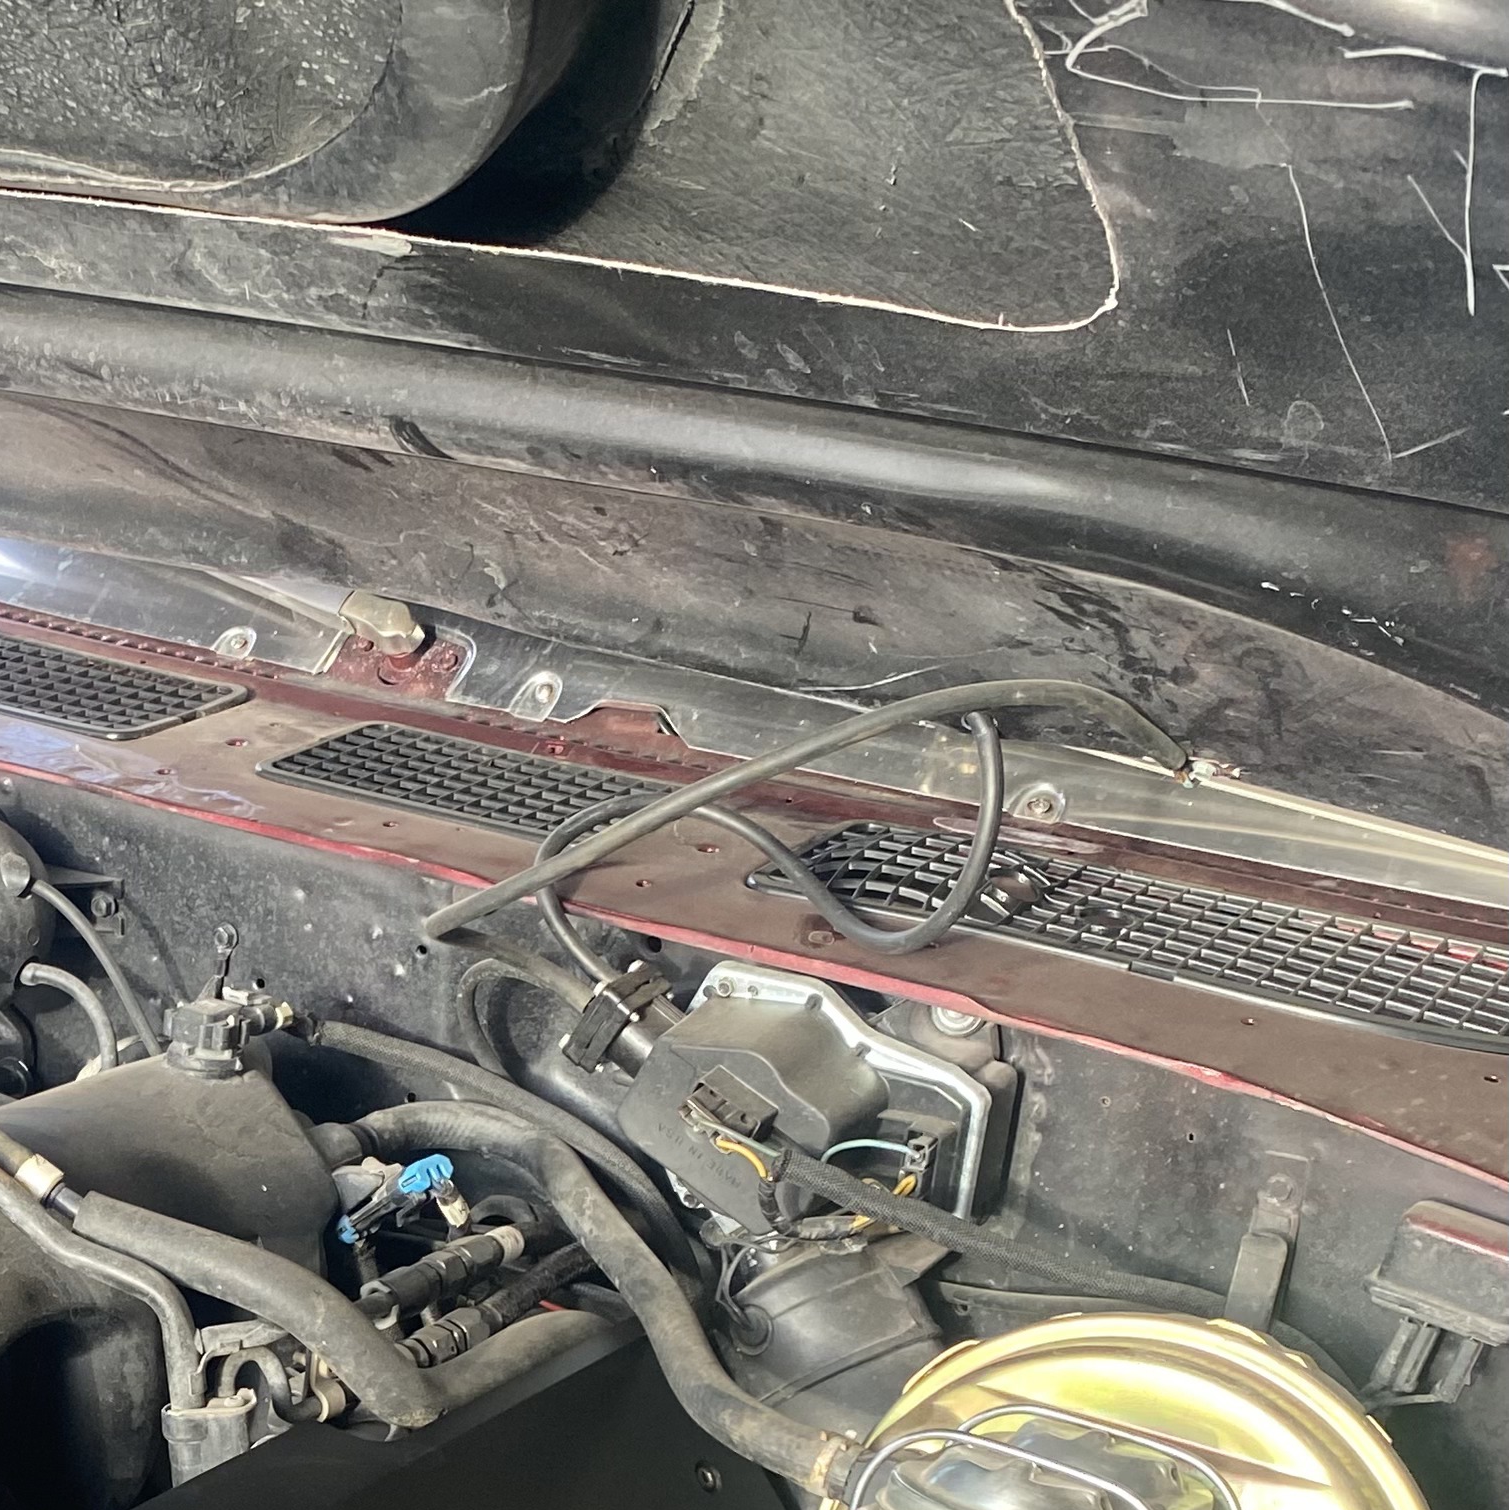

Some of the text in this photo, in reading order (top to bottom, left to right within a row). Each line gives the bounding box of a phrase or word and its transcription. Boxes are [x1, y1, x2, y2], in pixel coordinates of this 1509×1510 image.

[658, 1123, 741, 1189] MADE IN USA
